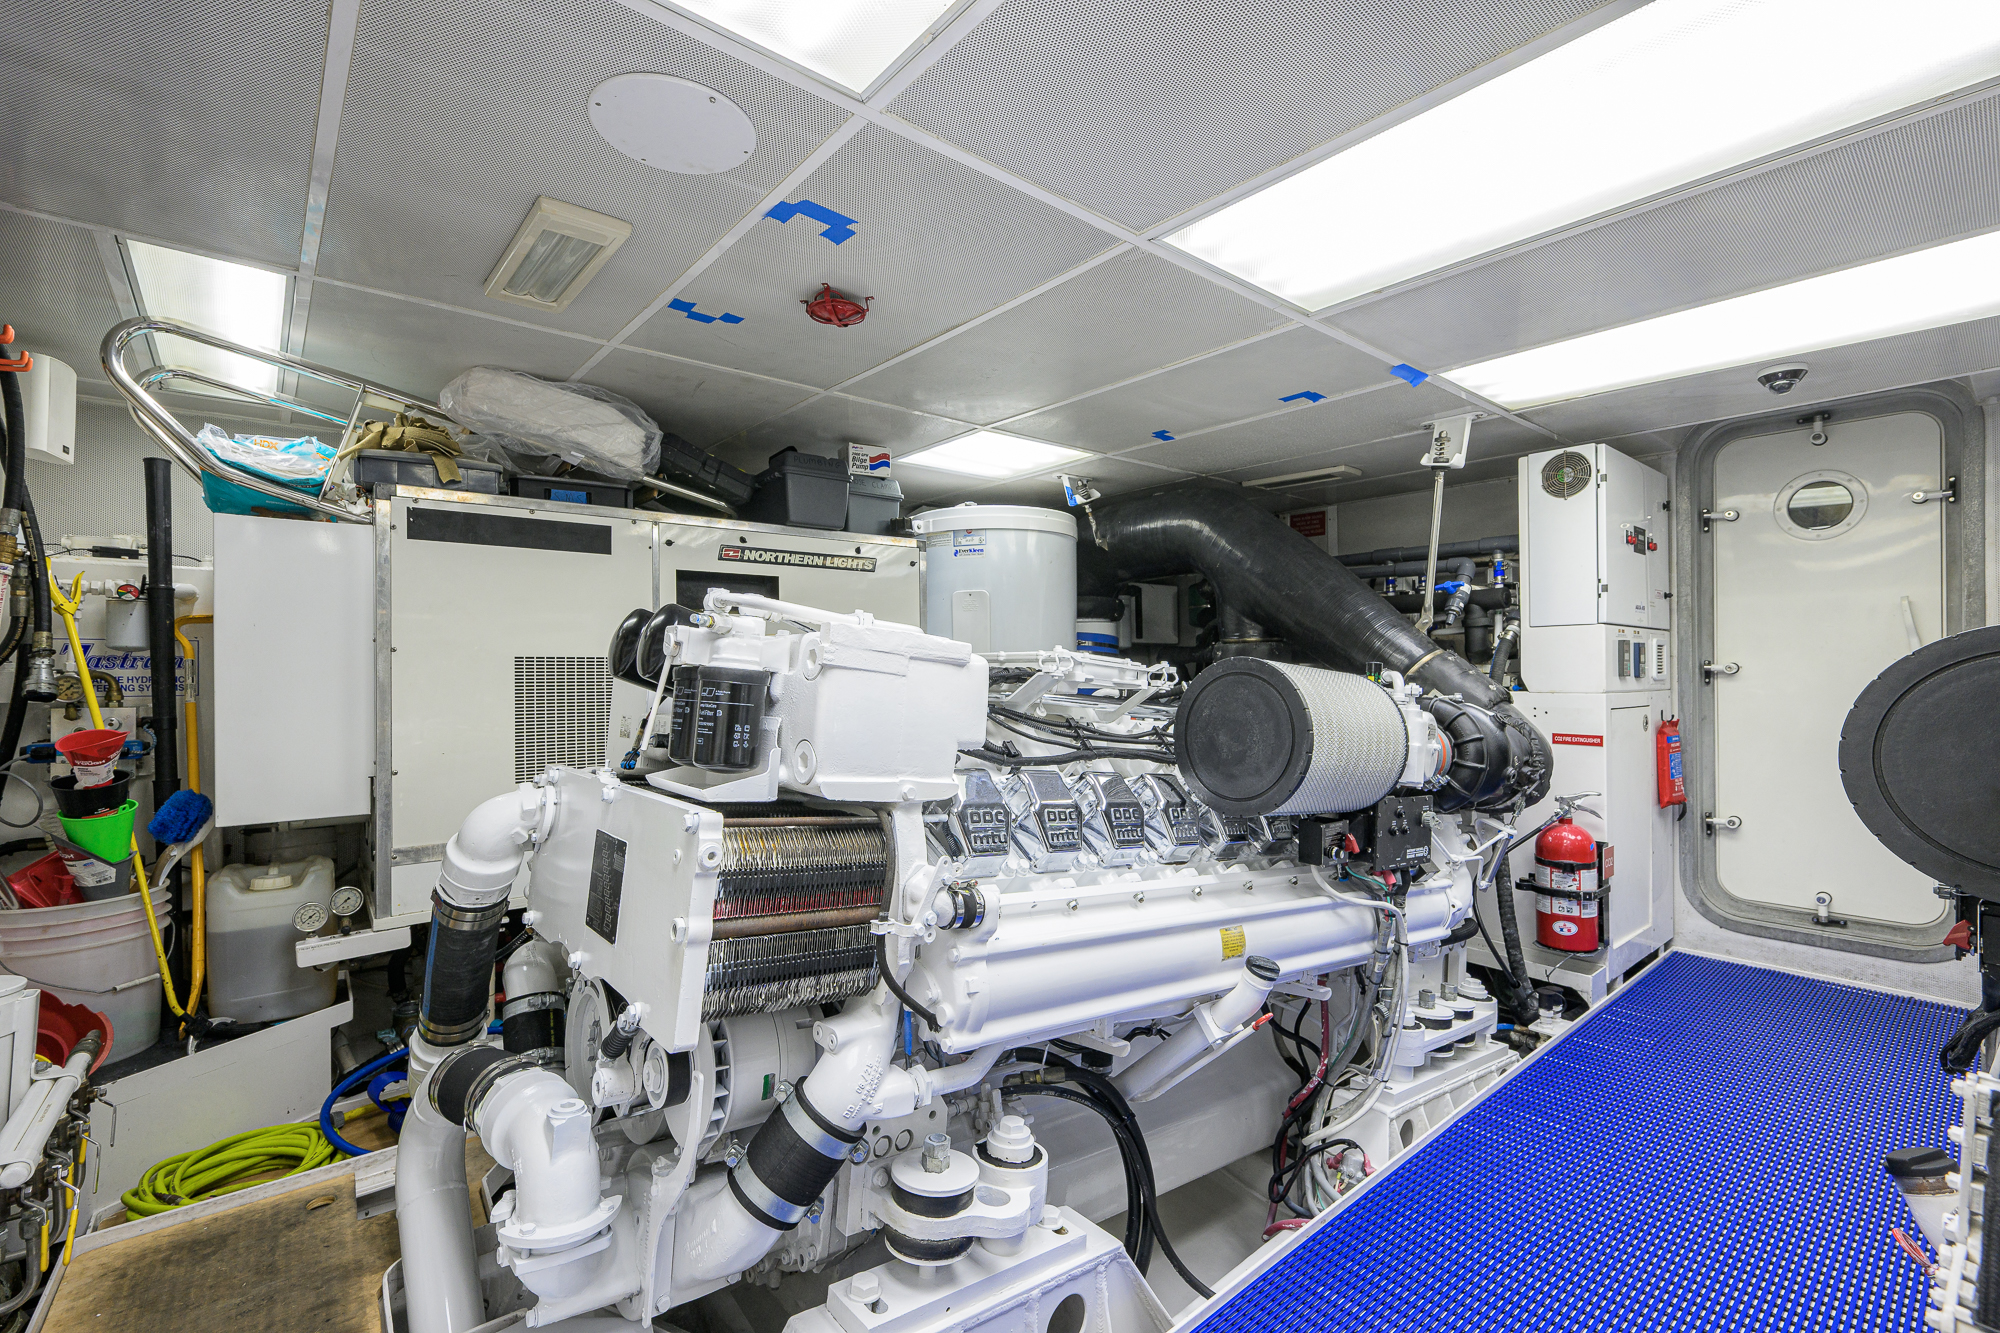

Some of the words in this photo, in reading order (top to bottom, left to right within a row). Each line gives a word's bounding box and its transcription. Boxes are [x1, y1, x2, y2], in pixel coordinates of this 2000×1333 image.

[254, 438, 278, 450] HDX
[794, 456, 841, 468] PLUMBING
[852, 463, 868, 471] Pump
[744, 550, 823, 566] NORTHERN
[826, 557, 874, 570] LIGHTS
[968, 809, 1005, 824] DDC
[1046, 809, 1078, 822] DDC
[1112, 808, 1140, 820] DDC
[972, 830, 1008, 844] mtu
[1050, 828, 1080, 842] mtu
[1116, 826, 1144, 839] mtu
